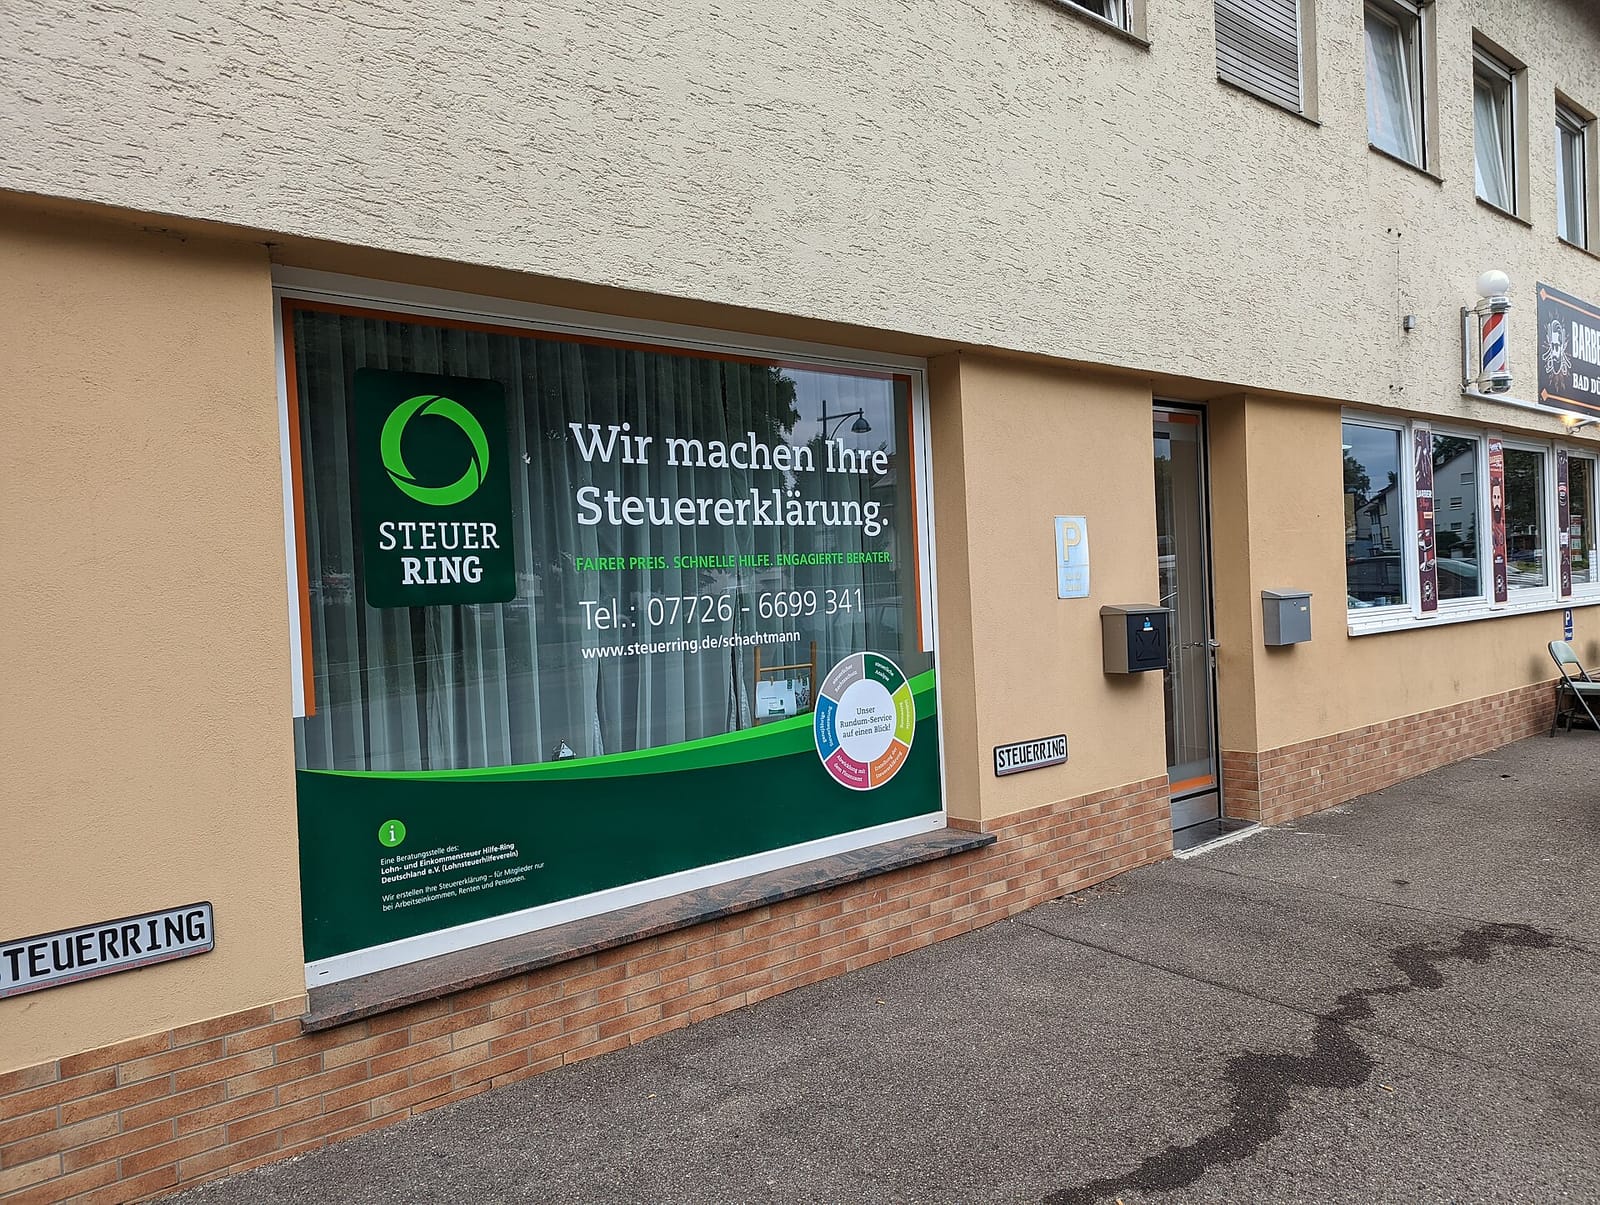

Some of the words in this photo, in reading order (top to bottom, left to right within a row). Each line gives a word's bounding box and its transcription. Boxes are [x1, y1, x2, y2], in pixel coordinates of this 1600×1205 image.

[1572, 373, 1589, 392] BAD
[568, 422, 652, 464] Wir
[666, 432, 815, 472] machen
[824, 438, 888, 474] Ihre
[576, 486, 888, 536] Steuererklärung.
[379, 521, 500, 550] STEUER
[1062, 521, 1082, 562] P
[401, 556, 484, 585] RING
[576, 556, 626, 571] FAIRER
[629, 556, 670, 570] PREIS.
[674, 554, 736, 569] SCHNELLE
[738, 553, 773, 567] HILFE.
[776, 552, 844, 566] ENGAGIERTE
[846, 551, 893, 564] BERATER.
[578, 598, 636, 630] Tel.:
[647, 594, 732, 626] 07726
[758, 590, 817, 618] 6699
[825, 588, 862, 615] 341
[582, 631, 800, 659] www.steuerring.de/schachtmann
[840, 714, 893, 728] Rundum-Service
[856, 706, 876, 715] Unser
[842, 728, 854, 738] auf
[854, 728, 872, 736] einen
[874, 723, 891, 734] Blick!
[998, 738, 1065, 768] STEUERRING
[380, 858, 395, 866] Eine
[396, 847, 445, 862] Beratungsstelle
[381, 866, 402, 874] Lohn-
[404, 861, 418, 870] und
[420, 850, 481, 866] Einkommensteuer
[483, 843, 515, 854] Hilfe-Ring
[381, 868, 426, 884] Deutschland
[428, 866, 441, 874] e.V.
[442, 850, 518, 872] (Lohnsteuerhilfeverein)
[382, 894, 394, 902] Wir
[396, 888, 424, 900] erstellen
[439, 874, 488, 890] Steuererklärung
[504, 864, 533, 876] Mitglieder
[382, 903, 394, 912] bei
[394, 890, 457, 909] Arbeitseinkommen,
[458, 884, 480, 895] Renten
[482, 881, 494, 890] und
[495, 875, 526, 886] Pensionen.
[0, 910, 206, 982] TEUERRING
